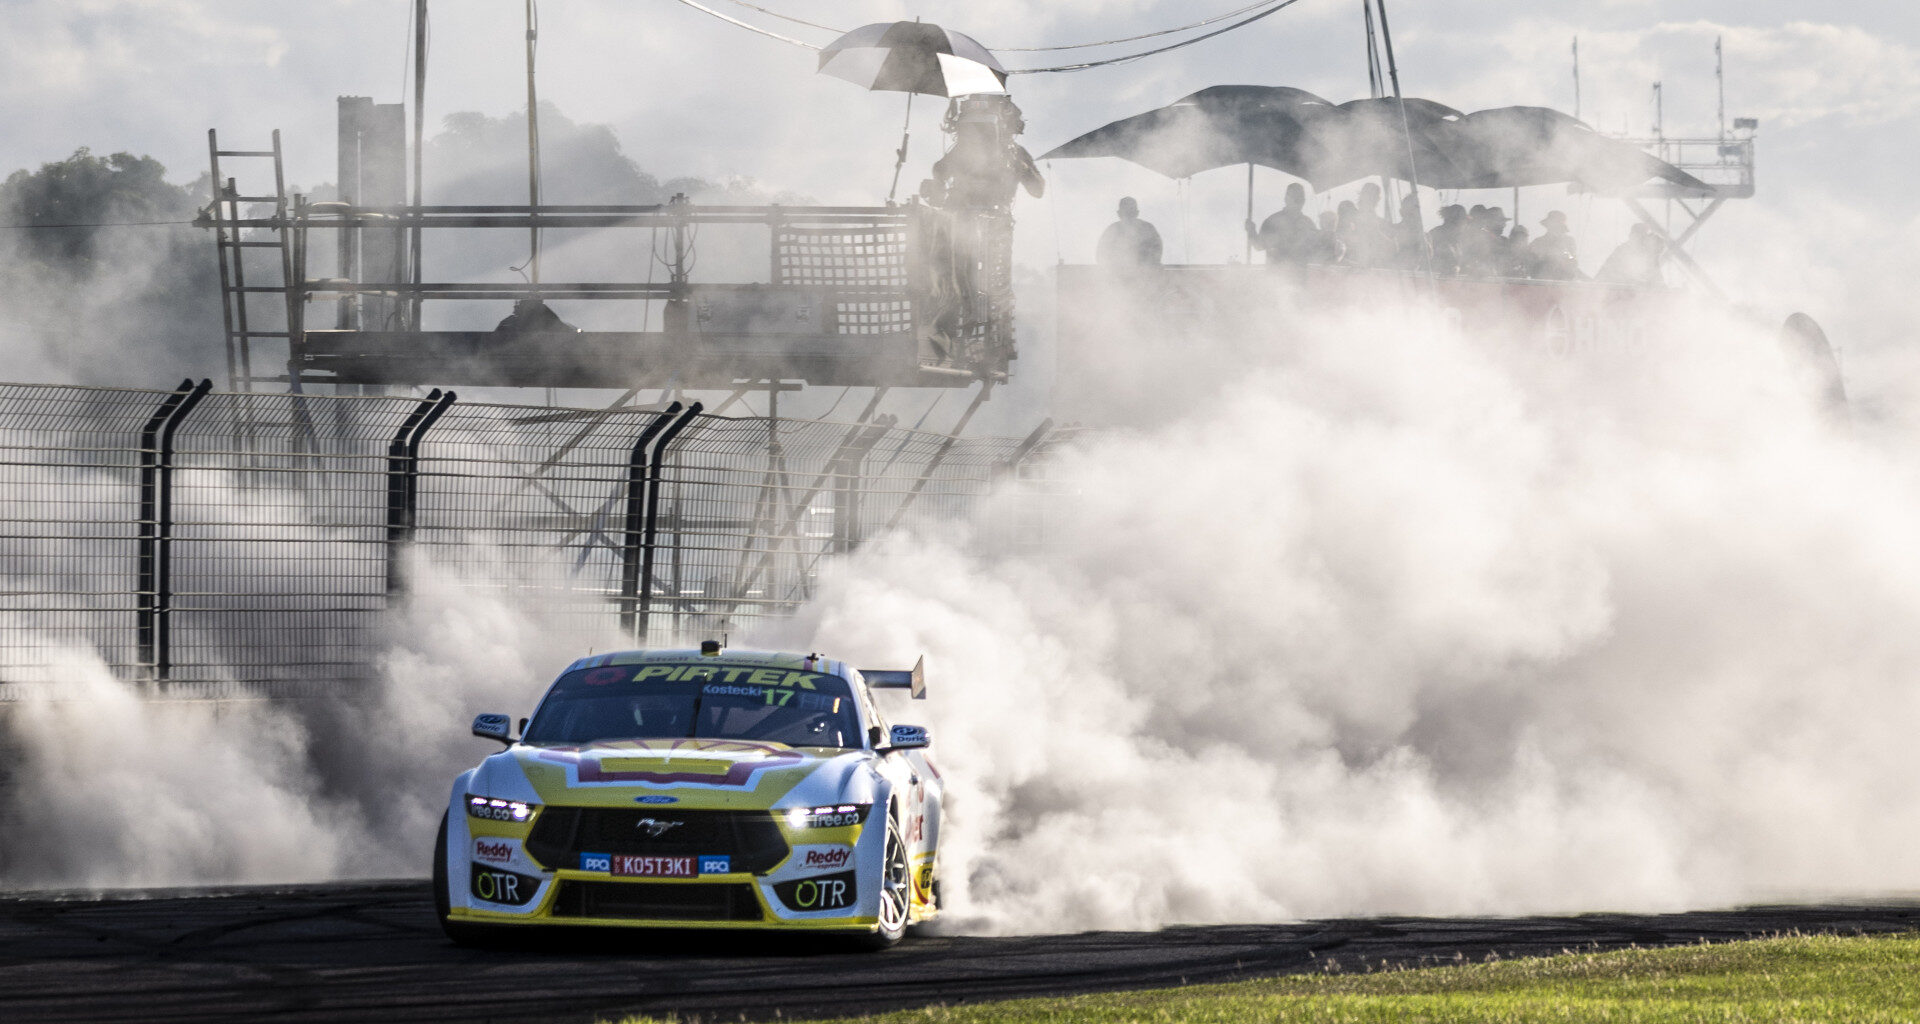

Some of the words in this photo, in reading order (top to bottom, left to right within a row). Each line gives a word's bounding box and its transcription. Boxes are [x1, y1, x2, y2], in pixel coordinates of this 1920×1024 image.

[632, 665, 824, 690] PIRTEK
[703, 684, 761, 696] Kostecki
[762, 688, 795, 707] 17
[476, 841, 512, 863] Reddy
[806, 848, 851, 868] Reddy
[585, 858, 610, 871] PPQ
[704, 861, 730, 873] PPQ
[478, 872, 520, 901] OTR
[796, 880, 846, 908] OTR
